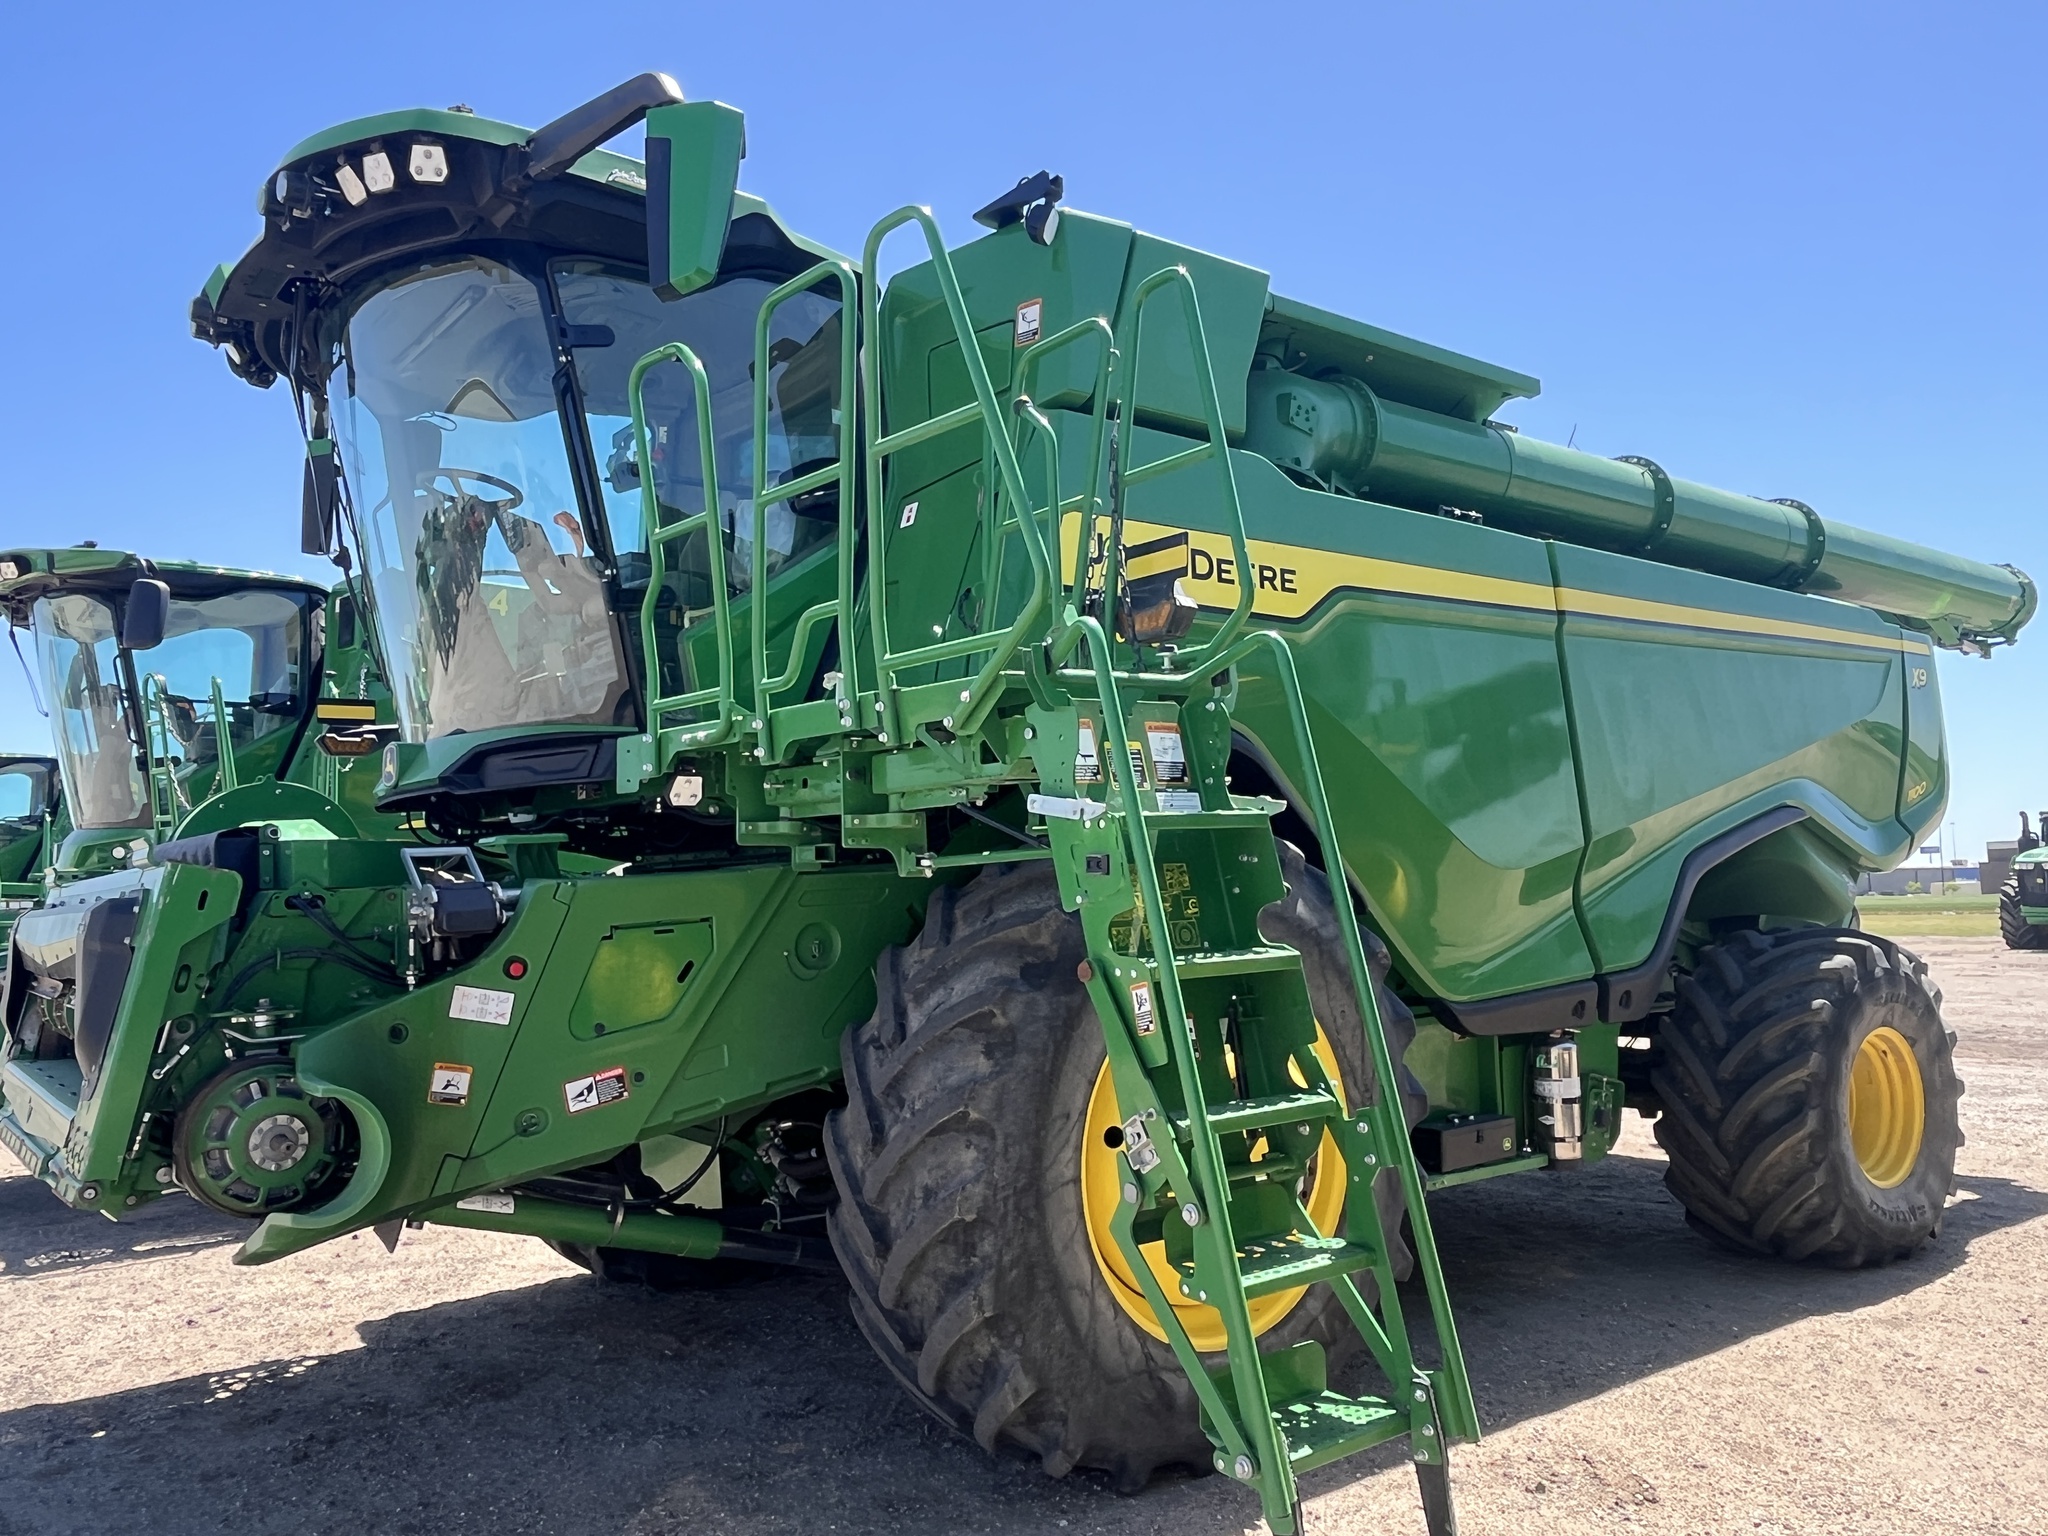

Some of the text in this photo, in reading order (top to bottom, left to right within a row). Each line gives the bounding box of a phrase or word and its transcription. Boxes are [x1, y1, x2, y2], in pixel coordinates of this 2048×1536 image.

[1190, 548, 1298, 595] DERE
[489, 588, 508, 617] 4
[1911, 667, 1927, 689] X9
